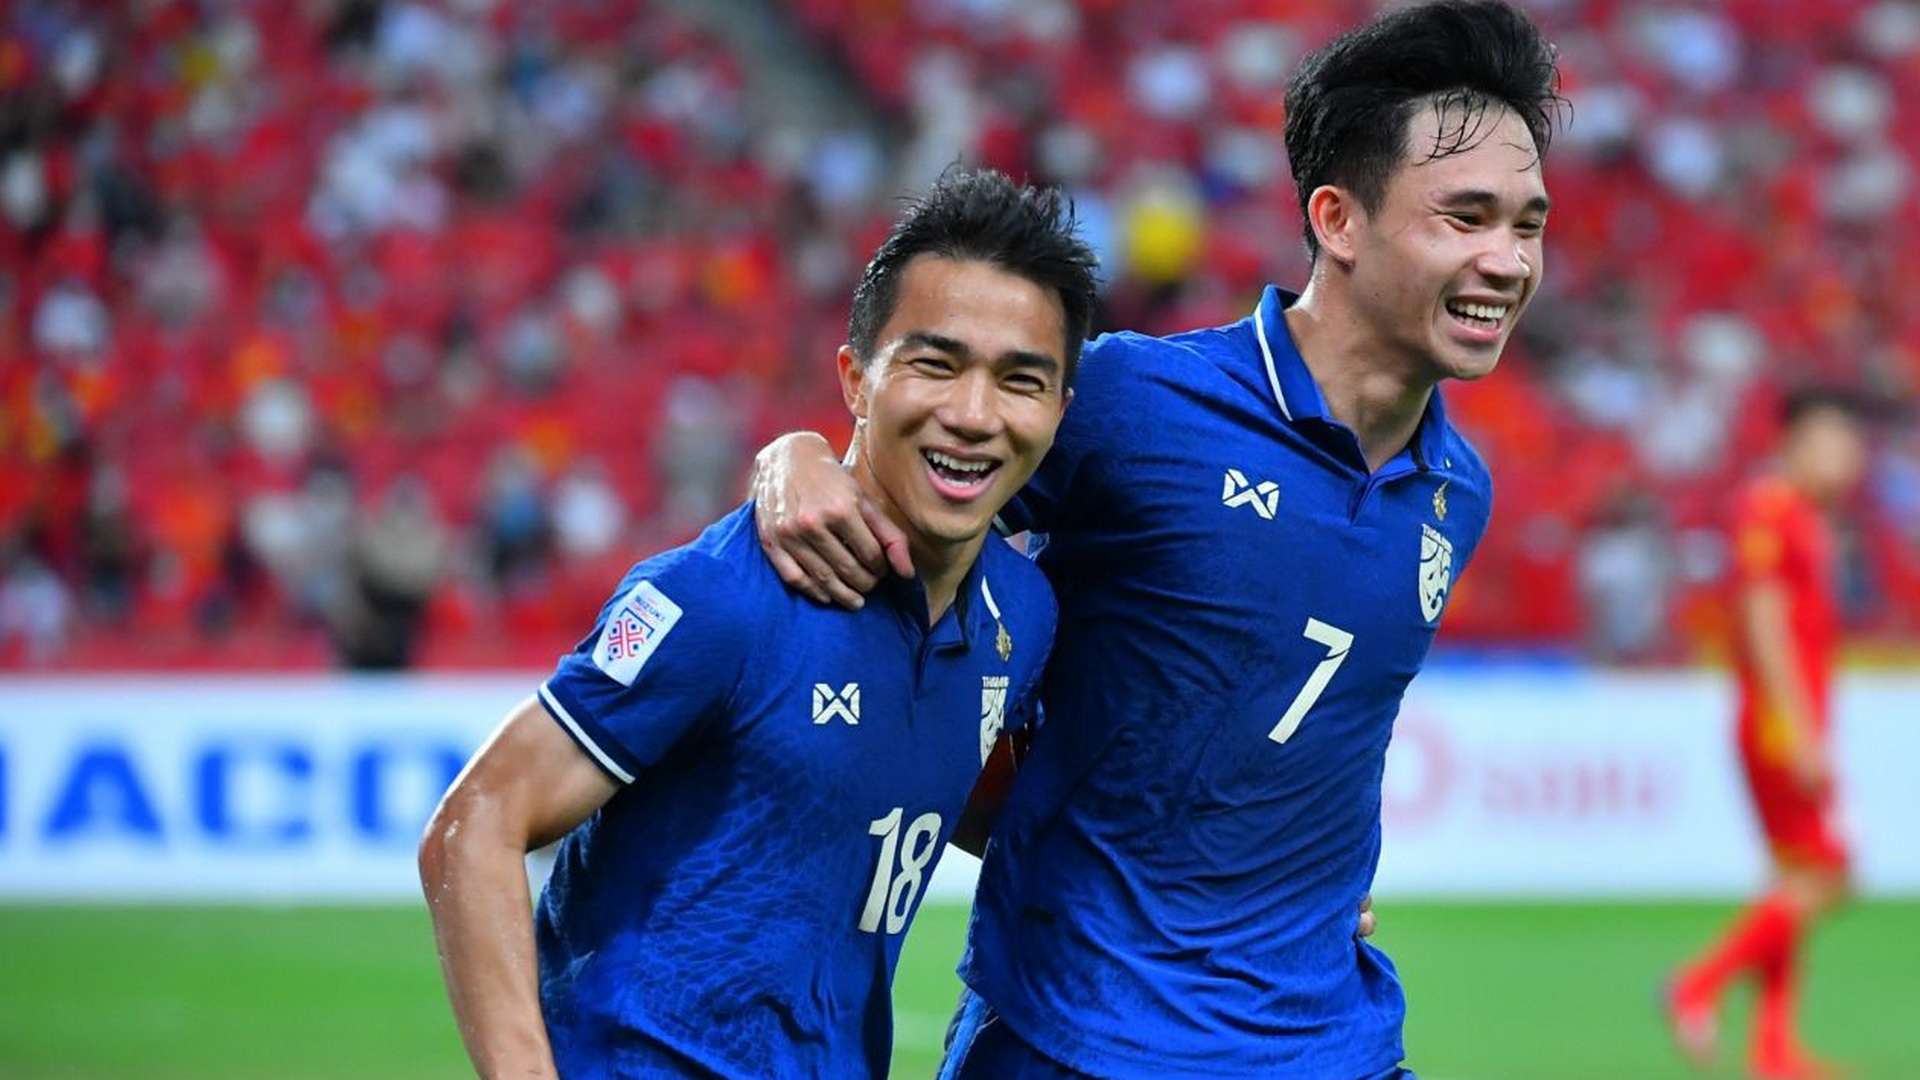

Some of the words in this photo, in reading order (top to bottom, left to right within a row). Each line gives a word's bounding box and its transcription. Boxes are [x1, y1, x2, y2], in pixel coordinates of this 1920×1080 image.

[1268, 617, 1354, 744] 7
[0, 738, 467, 844] ACO
[857, 807, 942, 935] 18
